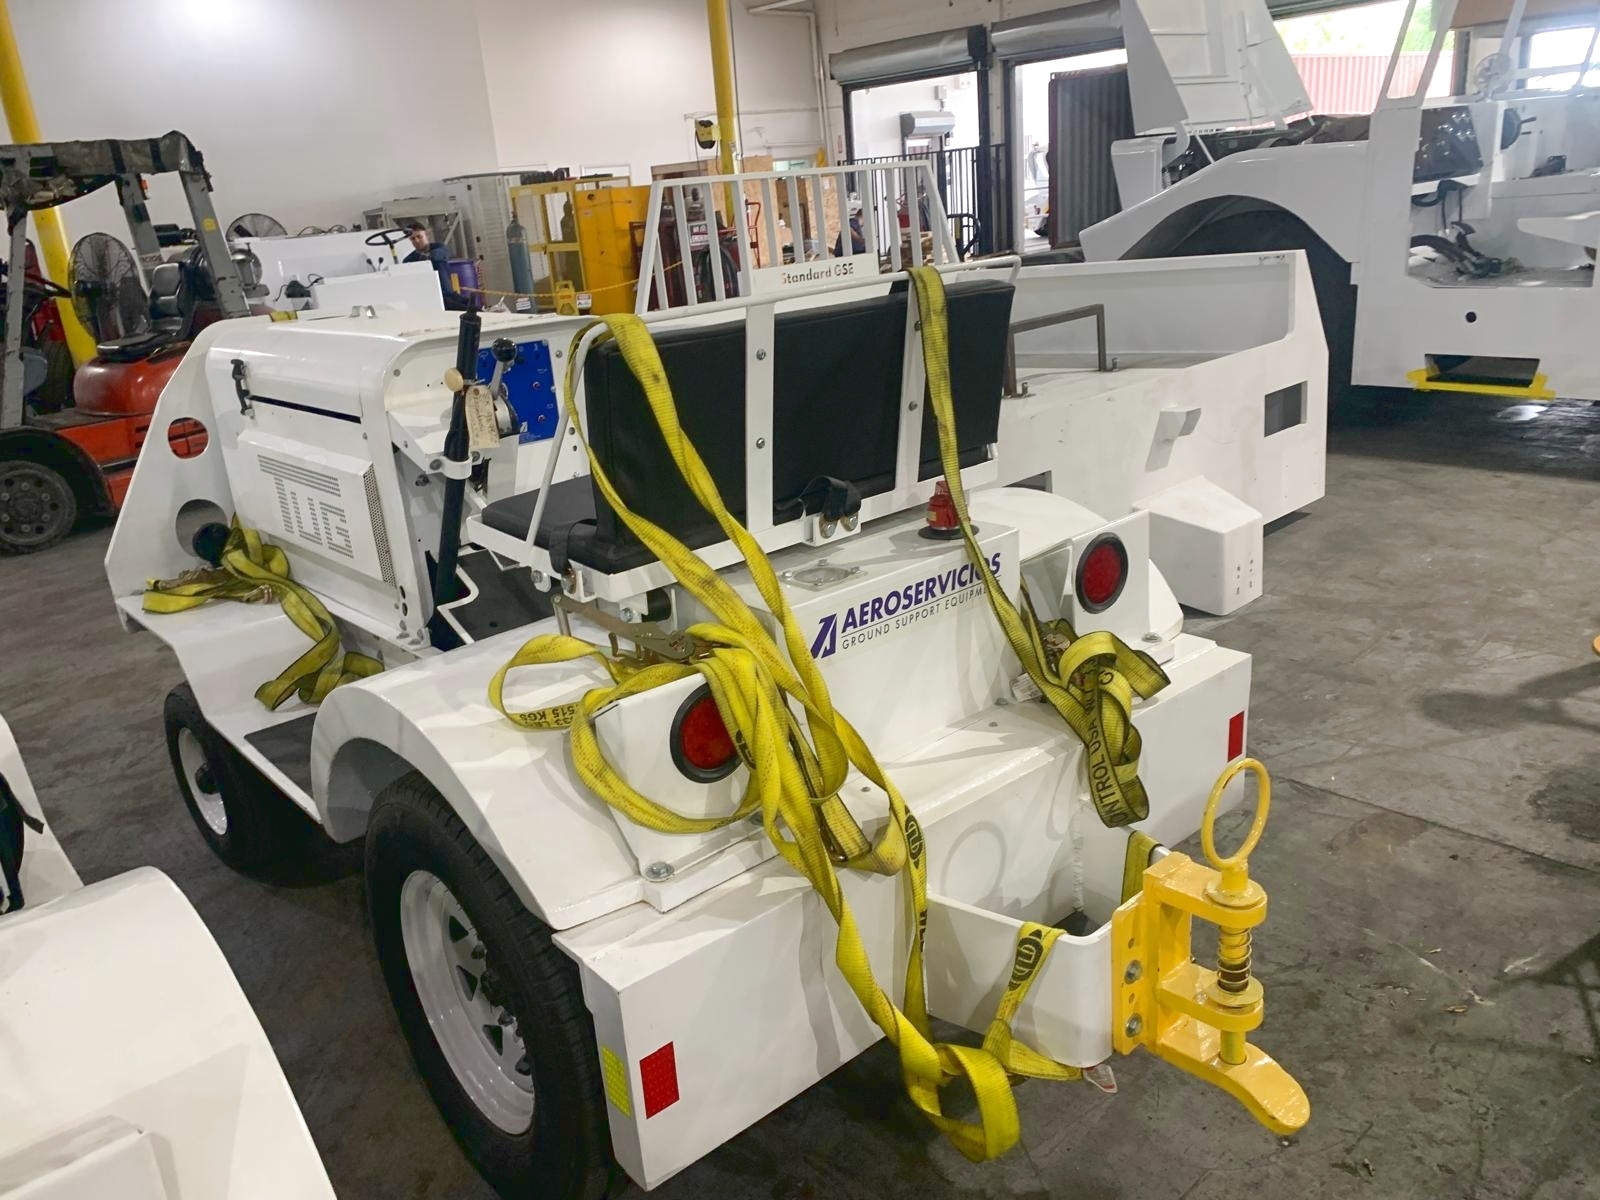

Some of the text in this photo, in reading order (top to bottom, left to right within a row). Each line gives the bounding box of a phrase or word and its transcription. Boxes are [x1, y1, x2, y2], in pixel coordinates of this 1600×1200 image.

[781, 262, 854, 285] Standard GSE
[842, 581, 996, 650] GROUND SUPPORT EQUIPME
